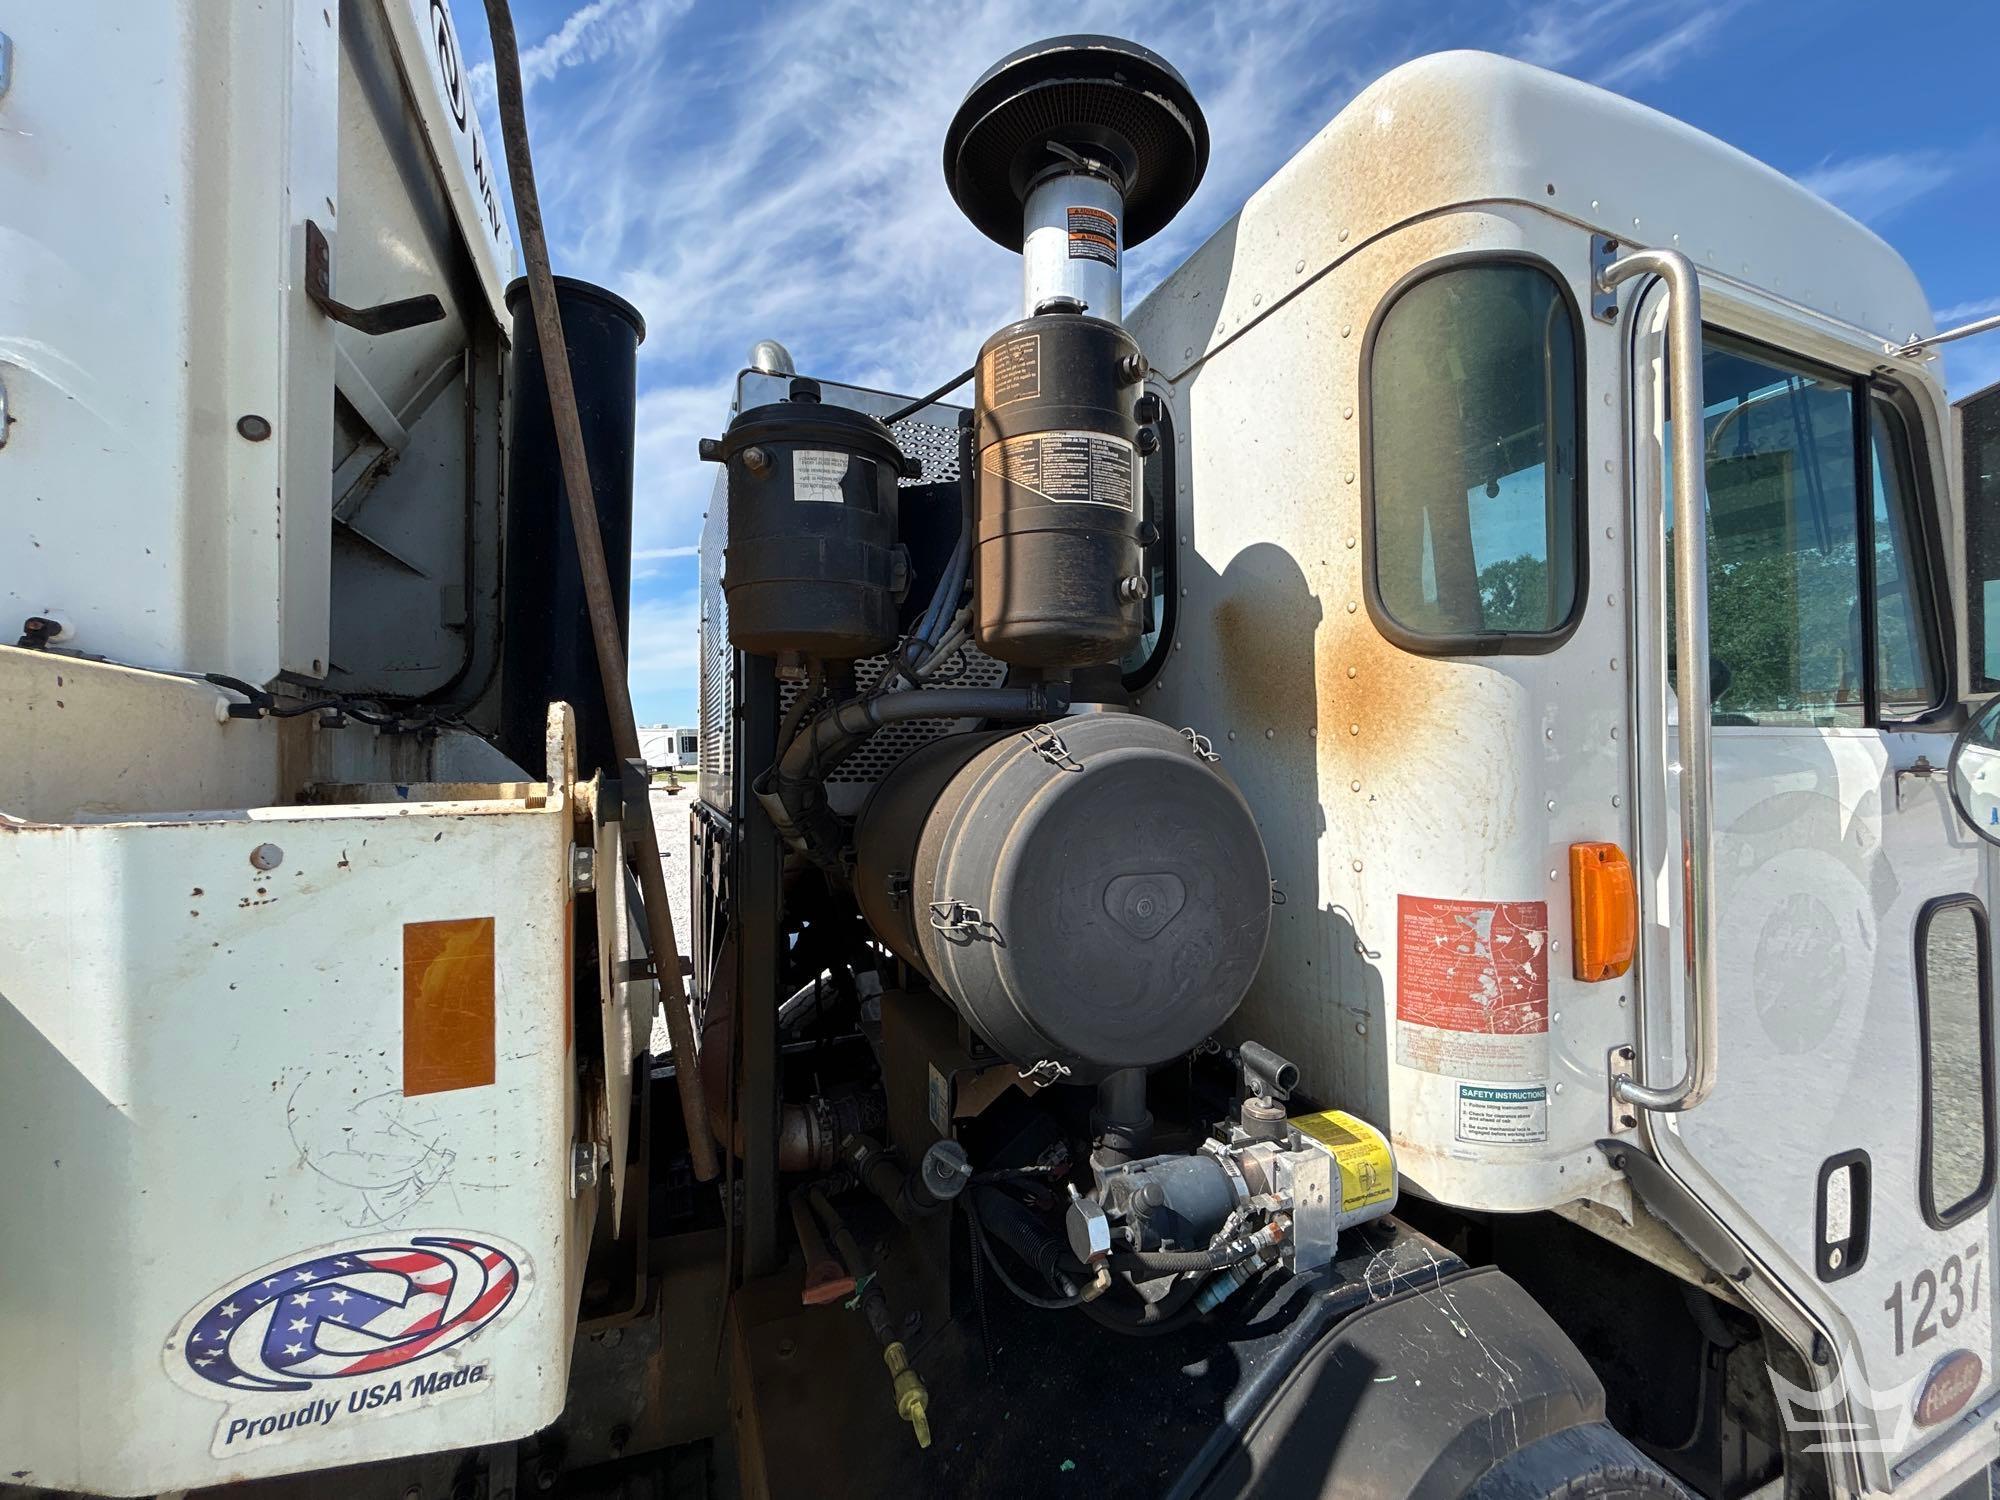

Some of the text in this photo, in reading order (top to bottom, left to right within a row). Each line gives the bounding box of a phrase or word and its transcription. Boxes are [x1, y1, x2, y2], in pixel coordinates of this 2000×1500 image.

[1462, 1088, 1545, 1100] SAFETY INSTRUCTIONS
[1884, 1242, 1982, 1357] 1237
[226, 1364, 487, 1445] Proudly USA Made
